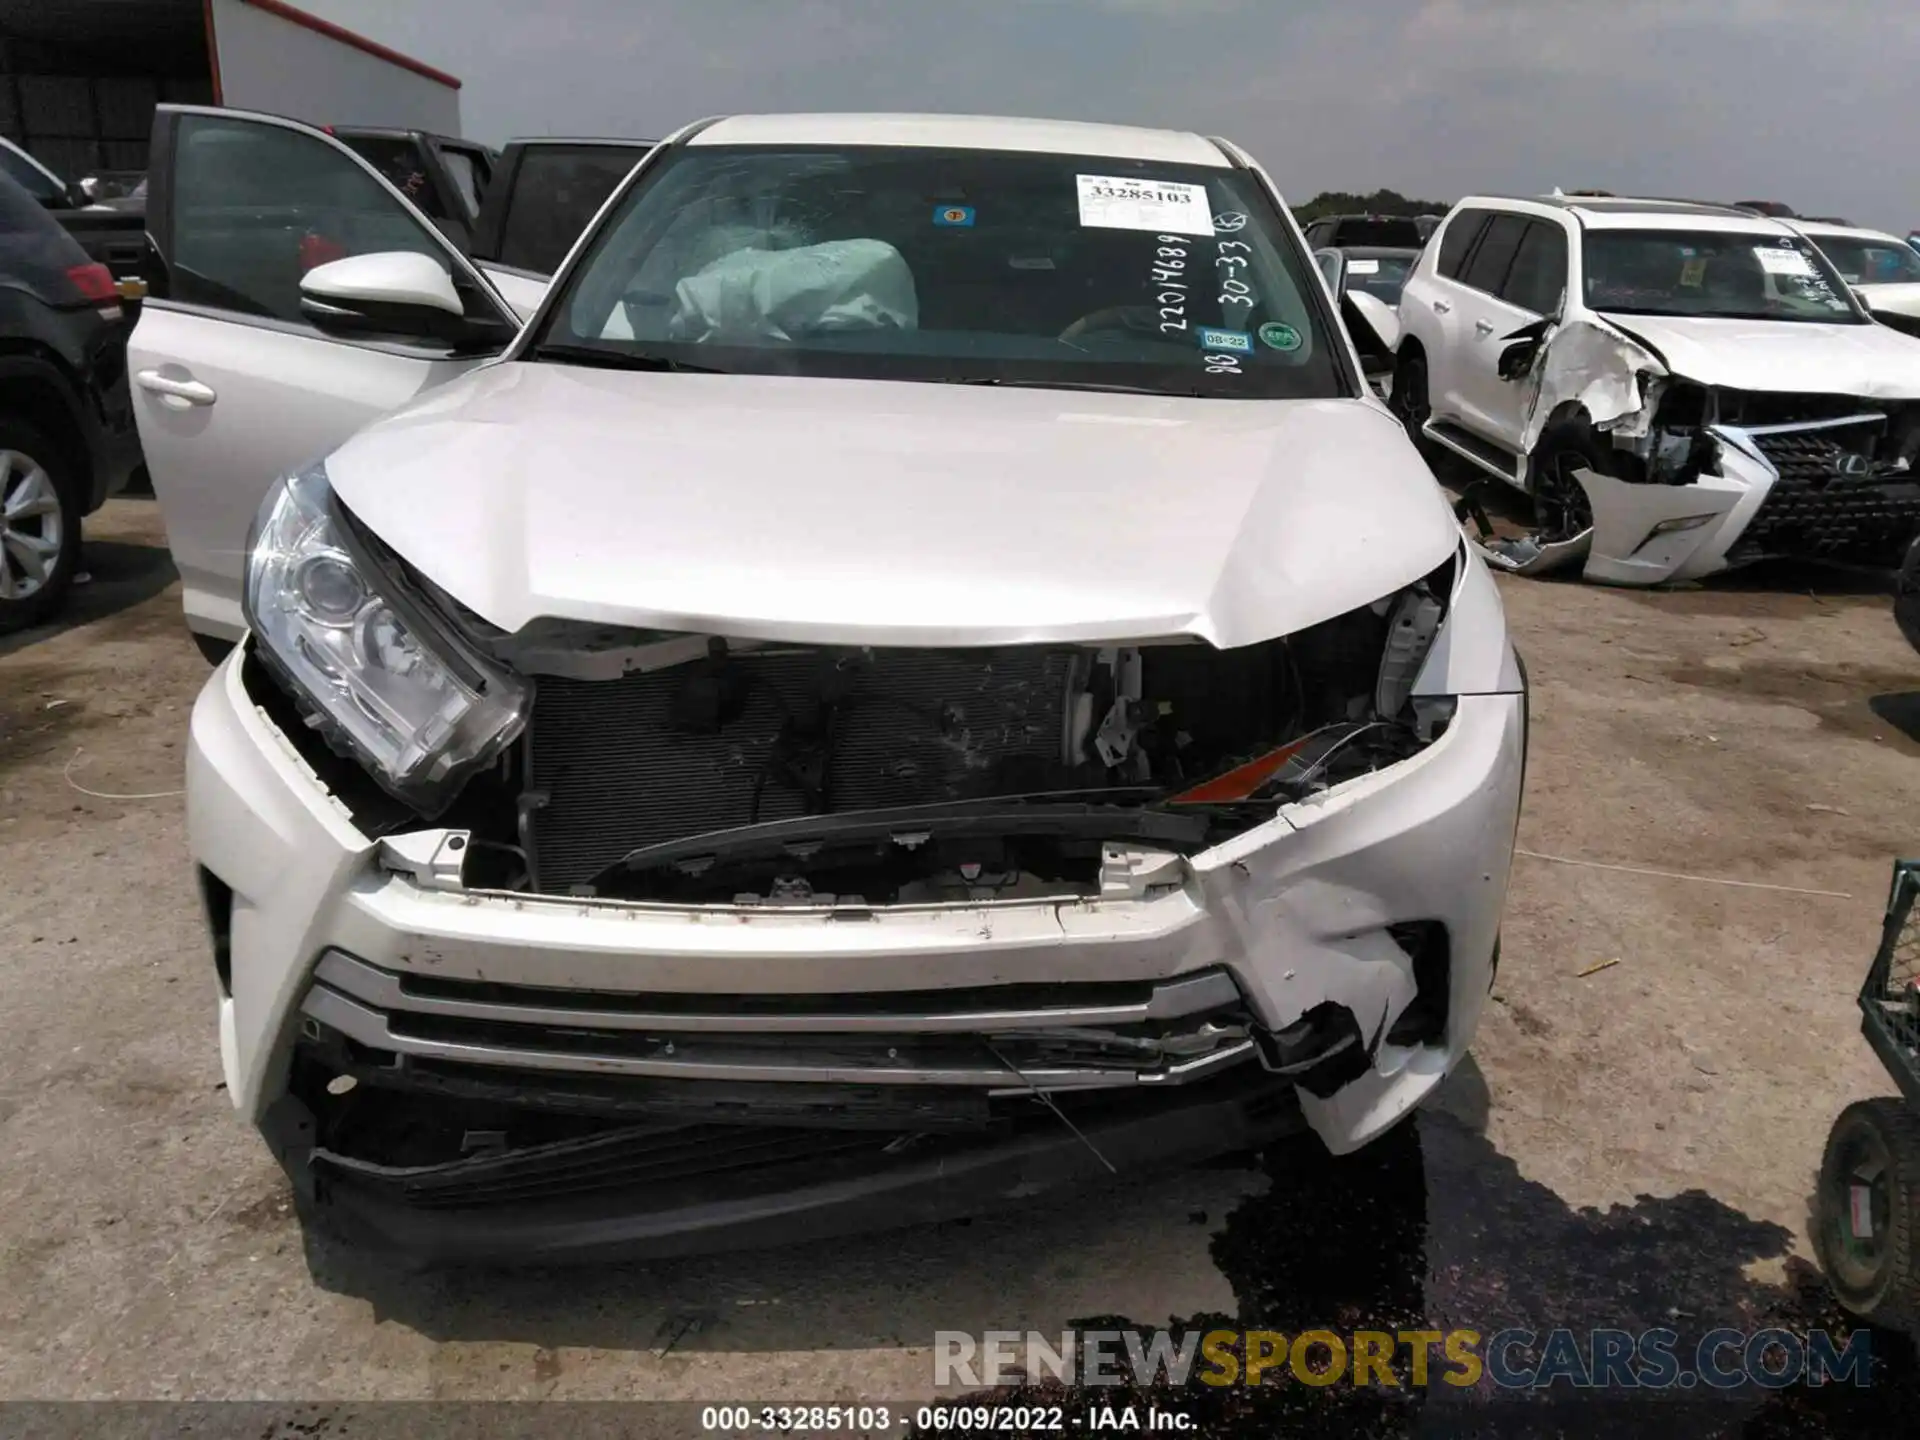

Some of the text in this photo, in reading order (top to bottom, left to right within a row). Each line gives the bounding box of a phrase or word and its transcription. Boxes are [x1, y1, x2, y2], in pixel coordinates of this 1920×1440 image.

[1091, 185, 1192, 205] 33285103
[1152, 235, 1191, 333] 22014689
[1216, 241, 1254, 308] 30-33
